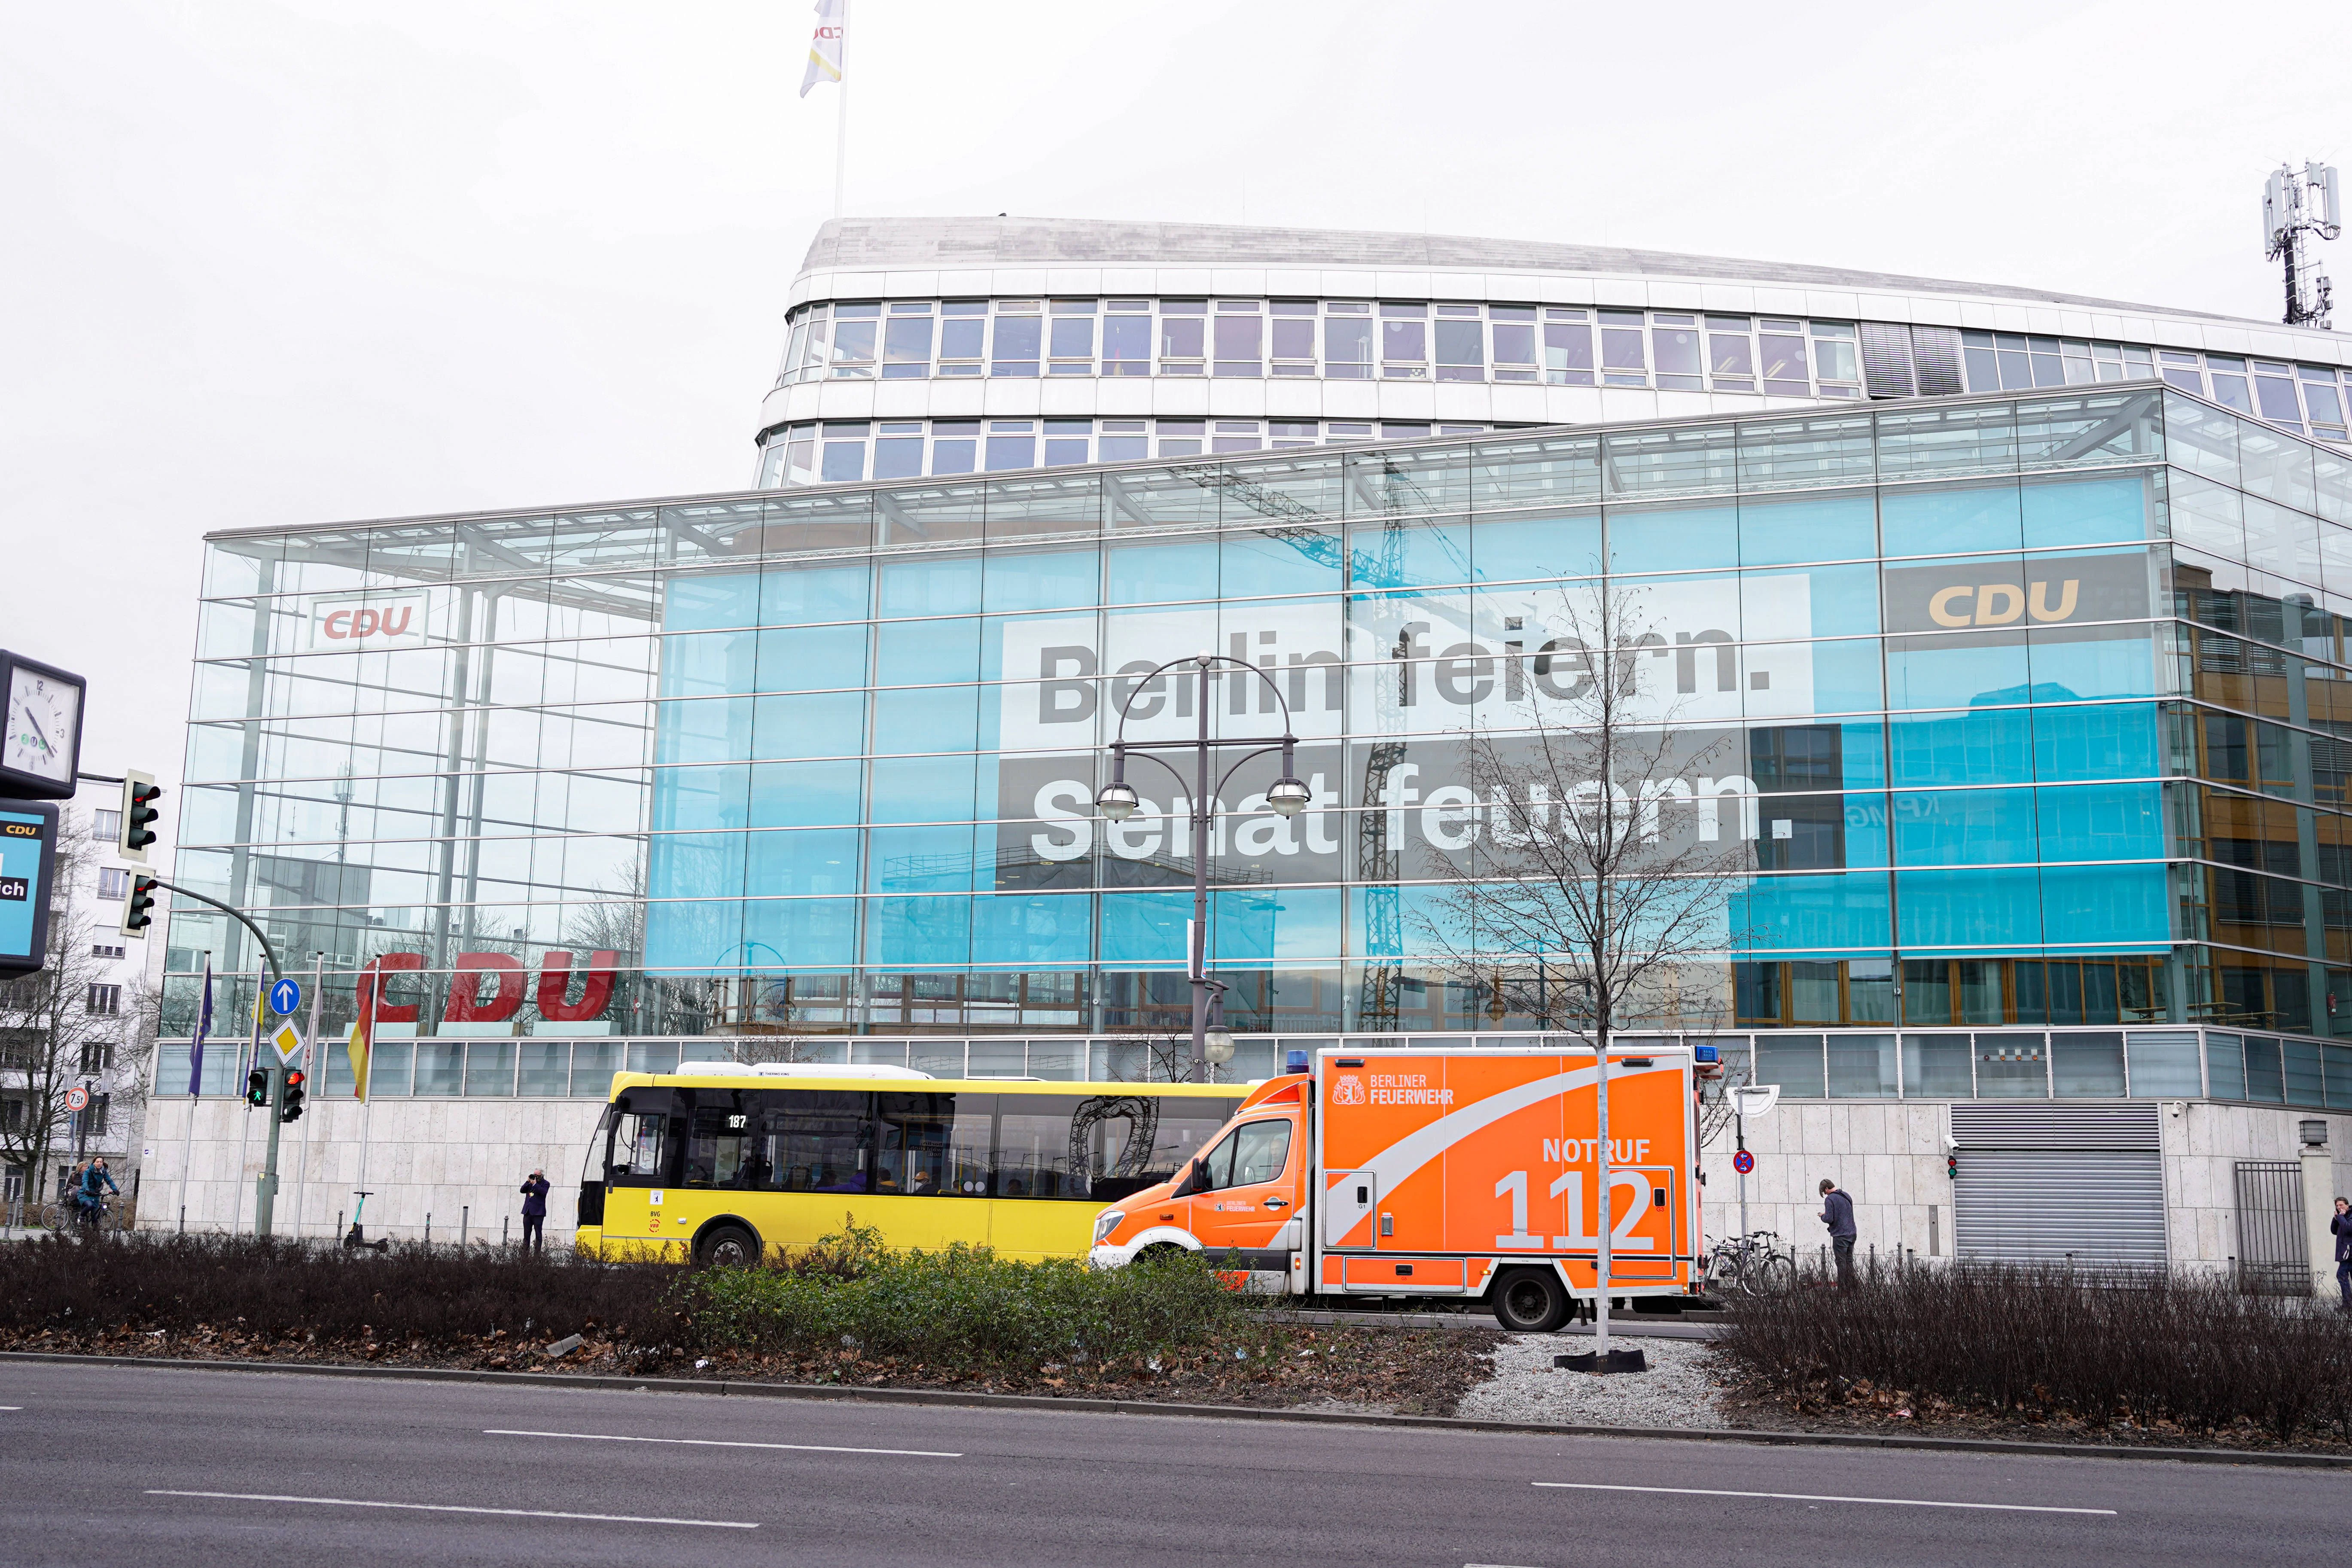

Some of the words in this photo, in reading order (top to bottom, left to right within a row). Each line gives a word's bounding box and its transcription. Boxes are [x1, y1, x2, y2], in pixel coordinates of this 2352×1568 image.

[1929, 579, 2079, 627] CDU
[324, 606, 412, 639] CDU
[1039, 631, 1342, 723] Berlin
[1392, 617, 1769, 707] feiern.
[37, 680, 43, 691] 12
[60, 728, 64, 738] 3
[1032, 773, 1338, 862] Senat
[1380, 763, 1792, 850] feuern.
[6, 825, 36, 835] CDU
[356, 950, 621, 1022] CDU
[1370, 1075, 1426, 1087] BERLINER
[1370, 1089, 1454, 1105] FEUERWEHR
[729, 1115, 746, 1128] 187
[1496, 1171, 1654, 1250] 112
